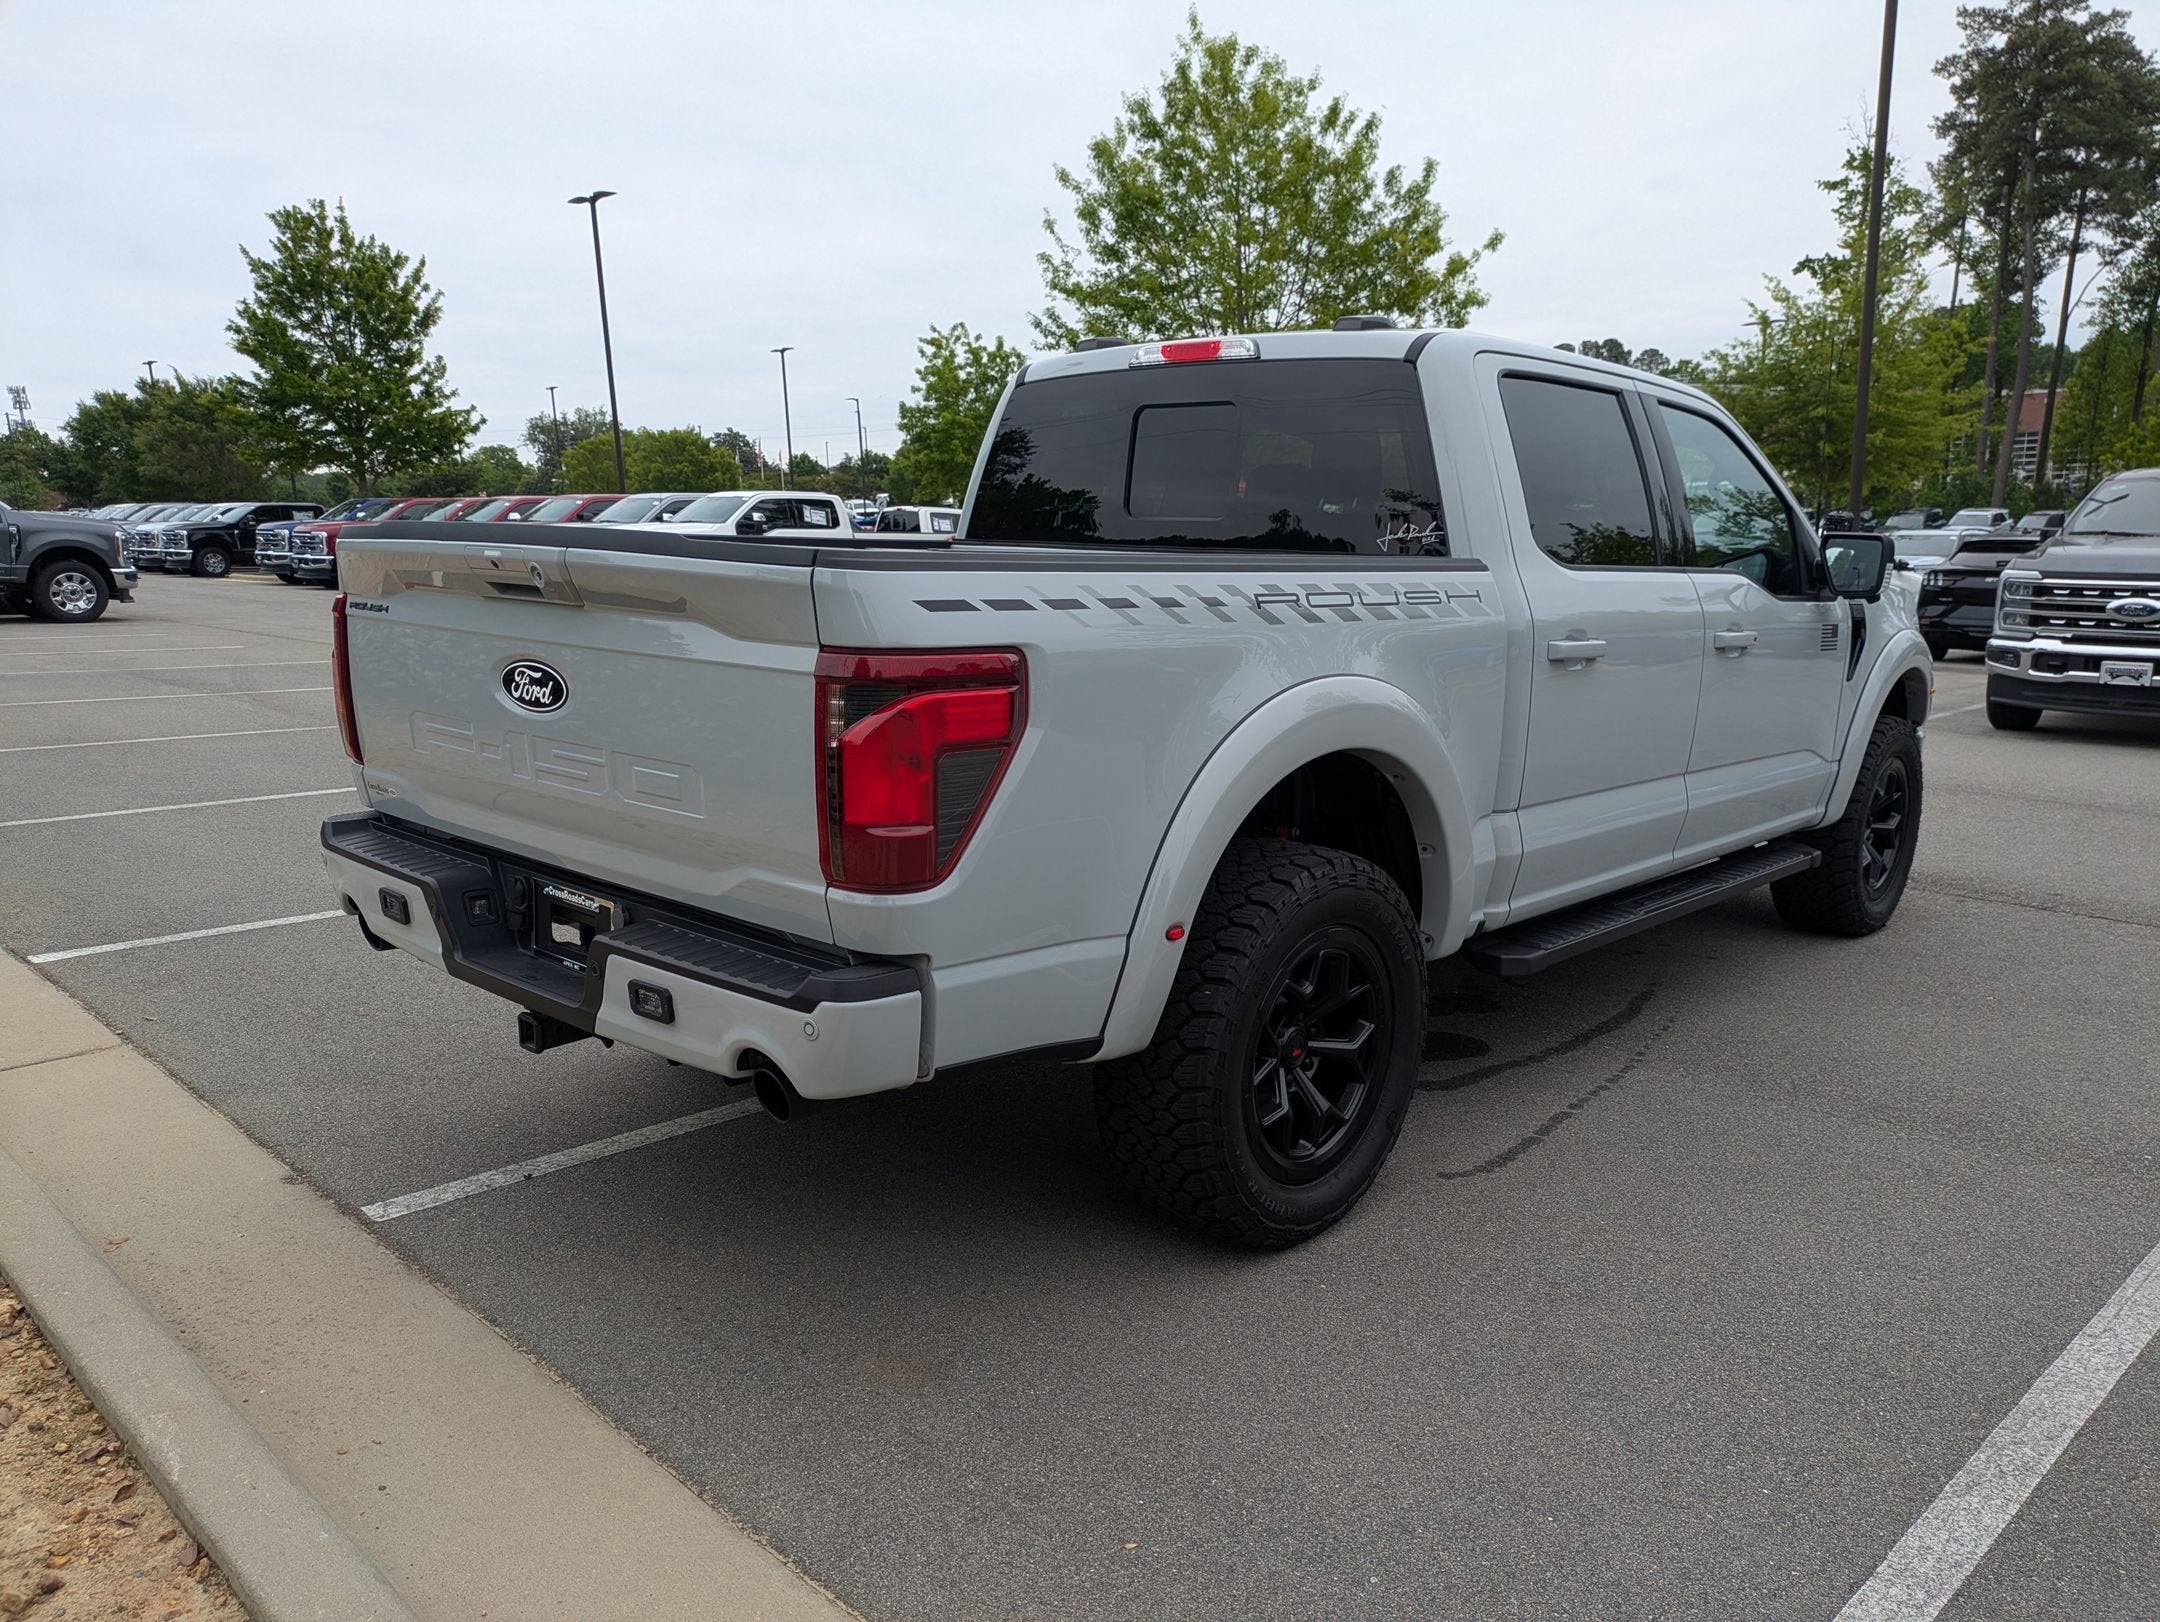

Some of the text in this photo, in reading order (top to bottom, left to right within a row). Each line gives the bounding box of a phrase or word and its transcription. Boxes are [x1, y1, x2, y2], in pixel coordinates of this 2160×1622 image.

[349, 602, 389, 613] ROUSH
[1253, 589, 1483, 610] ROUSH
[2121, 604, 2150, 616] Ford
[511, 667, 553, 704] Ford
[409, 710, 705, 819] F-150
